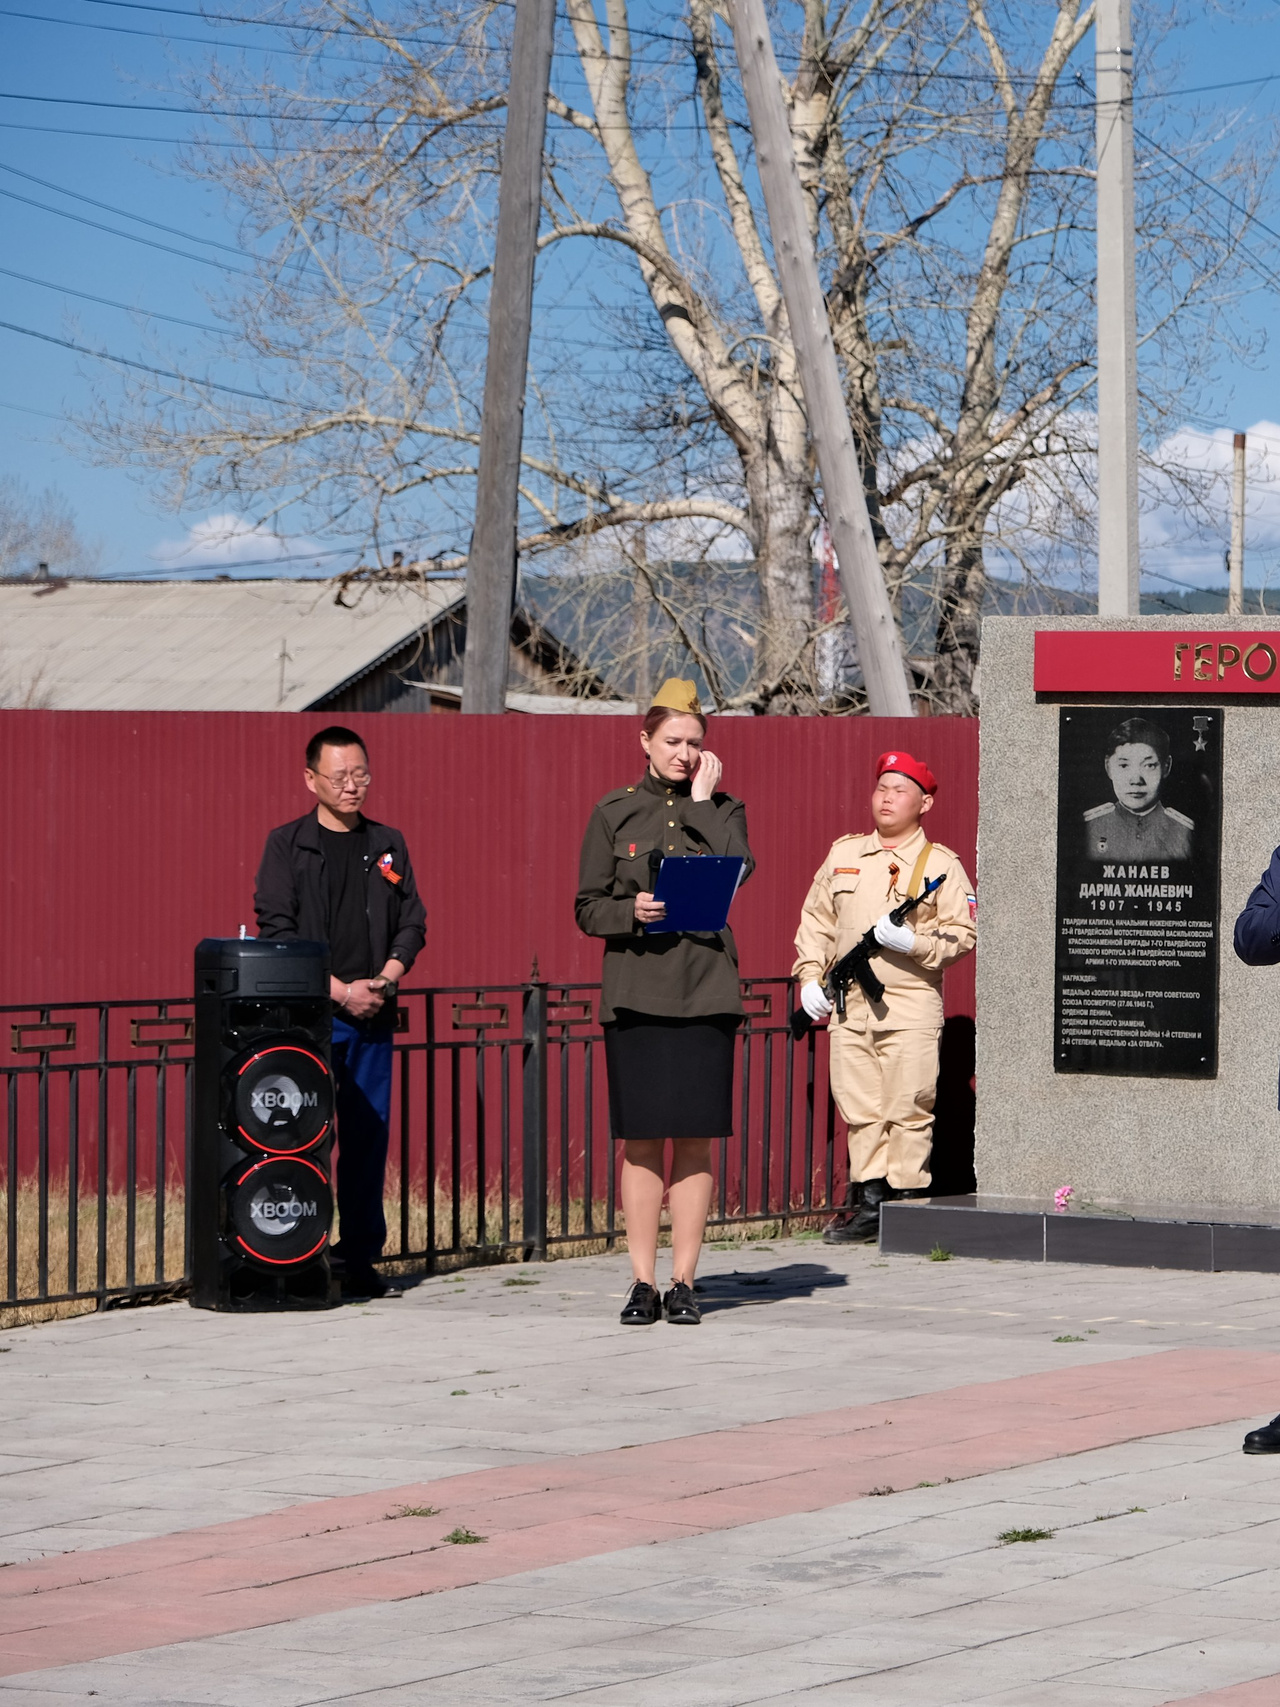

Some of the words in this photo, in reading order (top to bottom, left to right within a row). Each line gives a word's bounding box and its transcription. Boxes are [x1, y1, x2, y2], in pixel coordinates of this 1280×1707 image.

[1103, 865, 1170, 879] ЖАНАЕВ
[1079, 883, 1121, 898] ДАРМА
[1124, 884, 1193, 898] ЖАНАЕВИЧ
[1091, 900, 1125, 911] 1907
[1148, 901, 1182, 912] 1945
[1063, 918, 1087, 926] ГВАРДИИ
[1075, 928, 1112, 936] ГВАРДЕЙСКОЙ
[1114, 929, 1165, 937] МОТОСТРЕЛКОВОЙ
[1166, 930, 1213, 938] ВАСИЛЬКОВСКОЙ
[1069, 938, 1122, 946] КРАСНОЗНАМЕННОЙ
[1124, 939, 1150, 947] БРИГАДЫ
[1137, 949, 1176, 957] ГВАРДЕЙСКОЙ
[1118, 1020, 1146, 1028] ЗНАМЕНИ,
[1092, 1029, 1138, 1037] ОТЕЧЕСТВЕННОЙ
[251, 1092, 318, 1108] XBOOM
[250, 1201, 317, 1218] XBOOM
